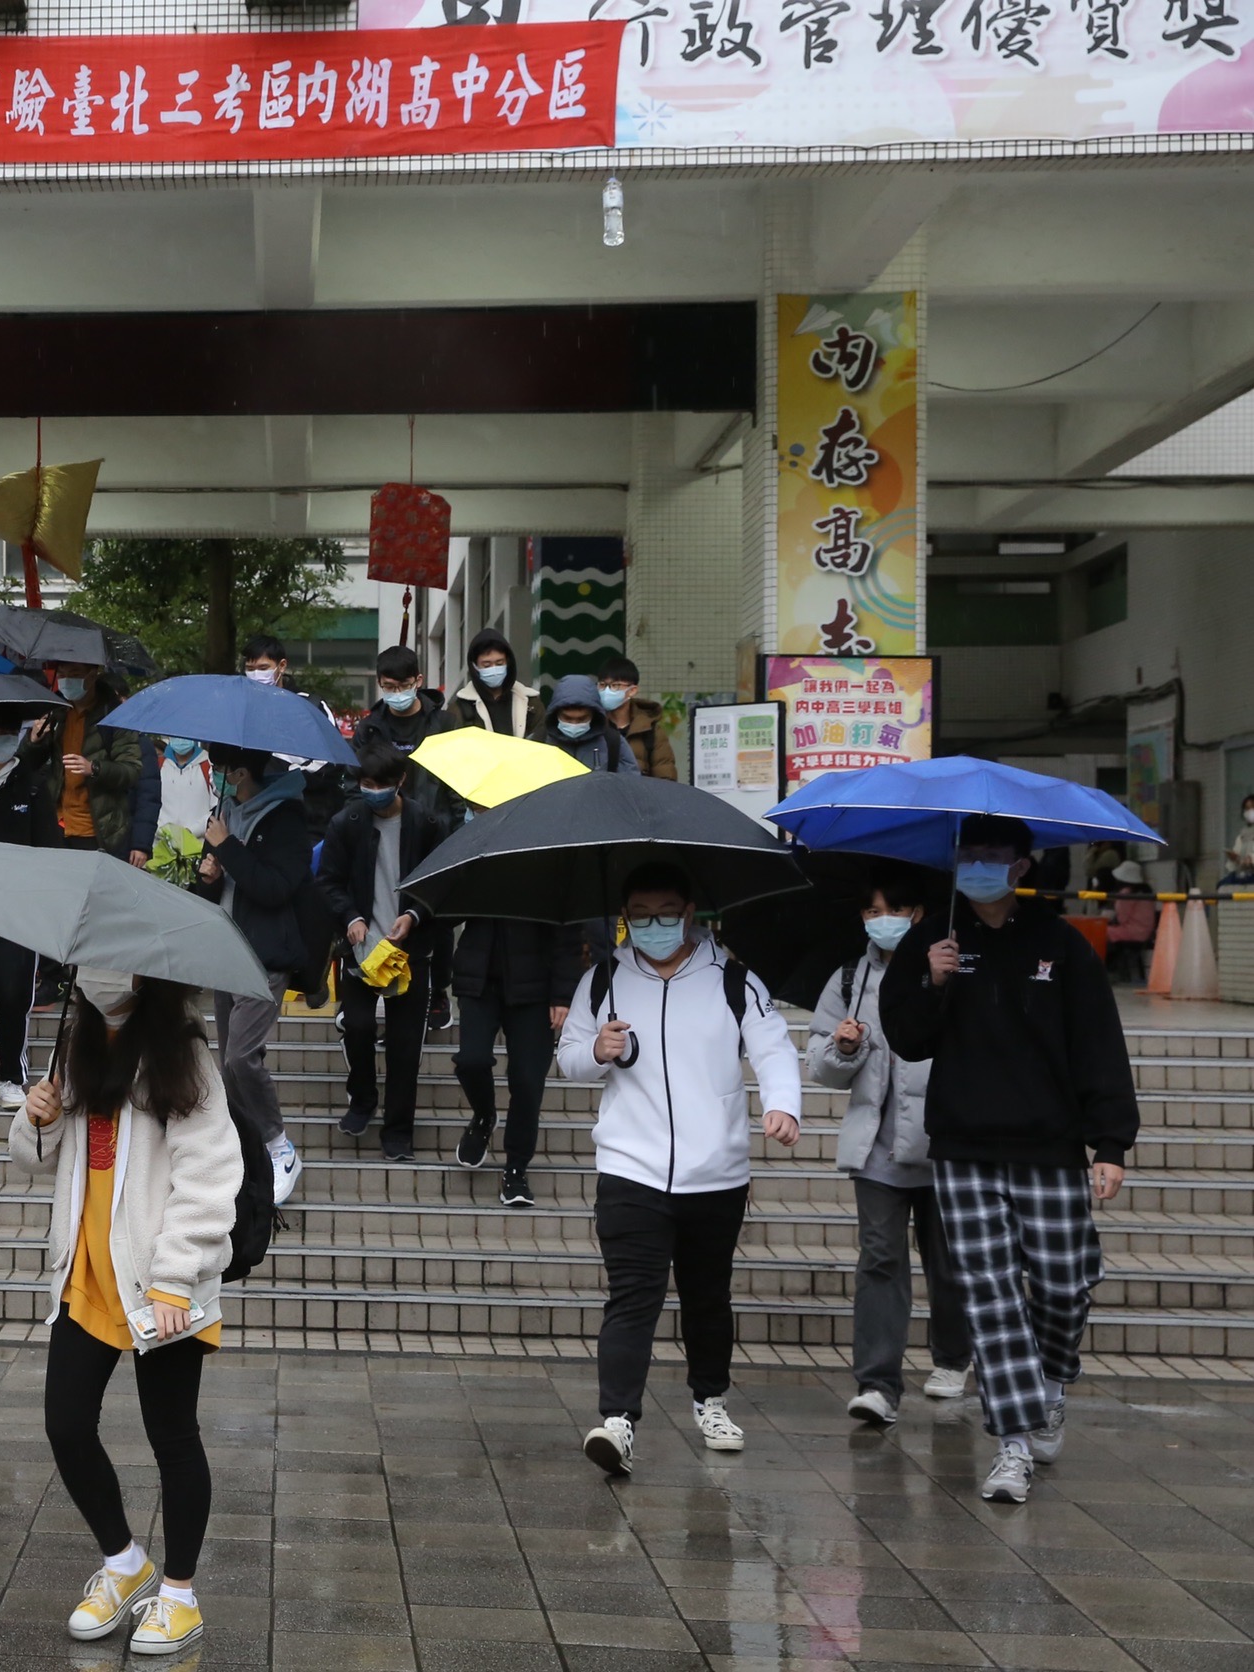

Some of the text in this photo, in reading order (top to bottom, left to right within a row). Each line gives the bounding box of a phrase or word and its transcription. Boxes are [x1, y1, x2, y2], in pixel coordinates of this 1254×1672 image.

[803, 680, 895, 694] 讓我們一起為
[792, 721, 903, 750] 加油打氣
